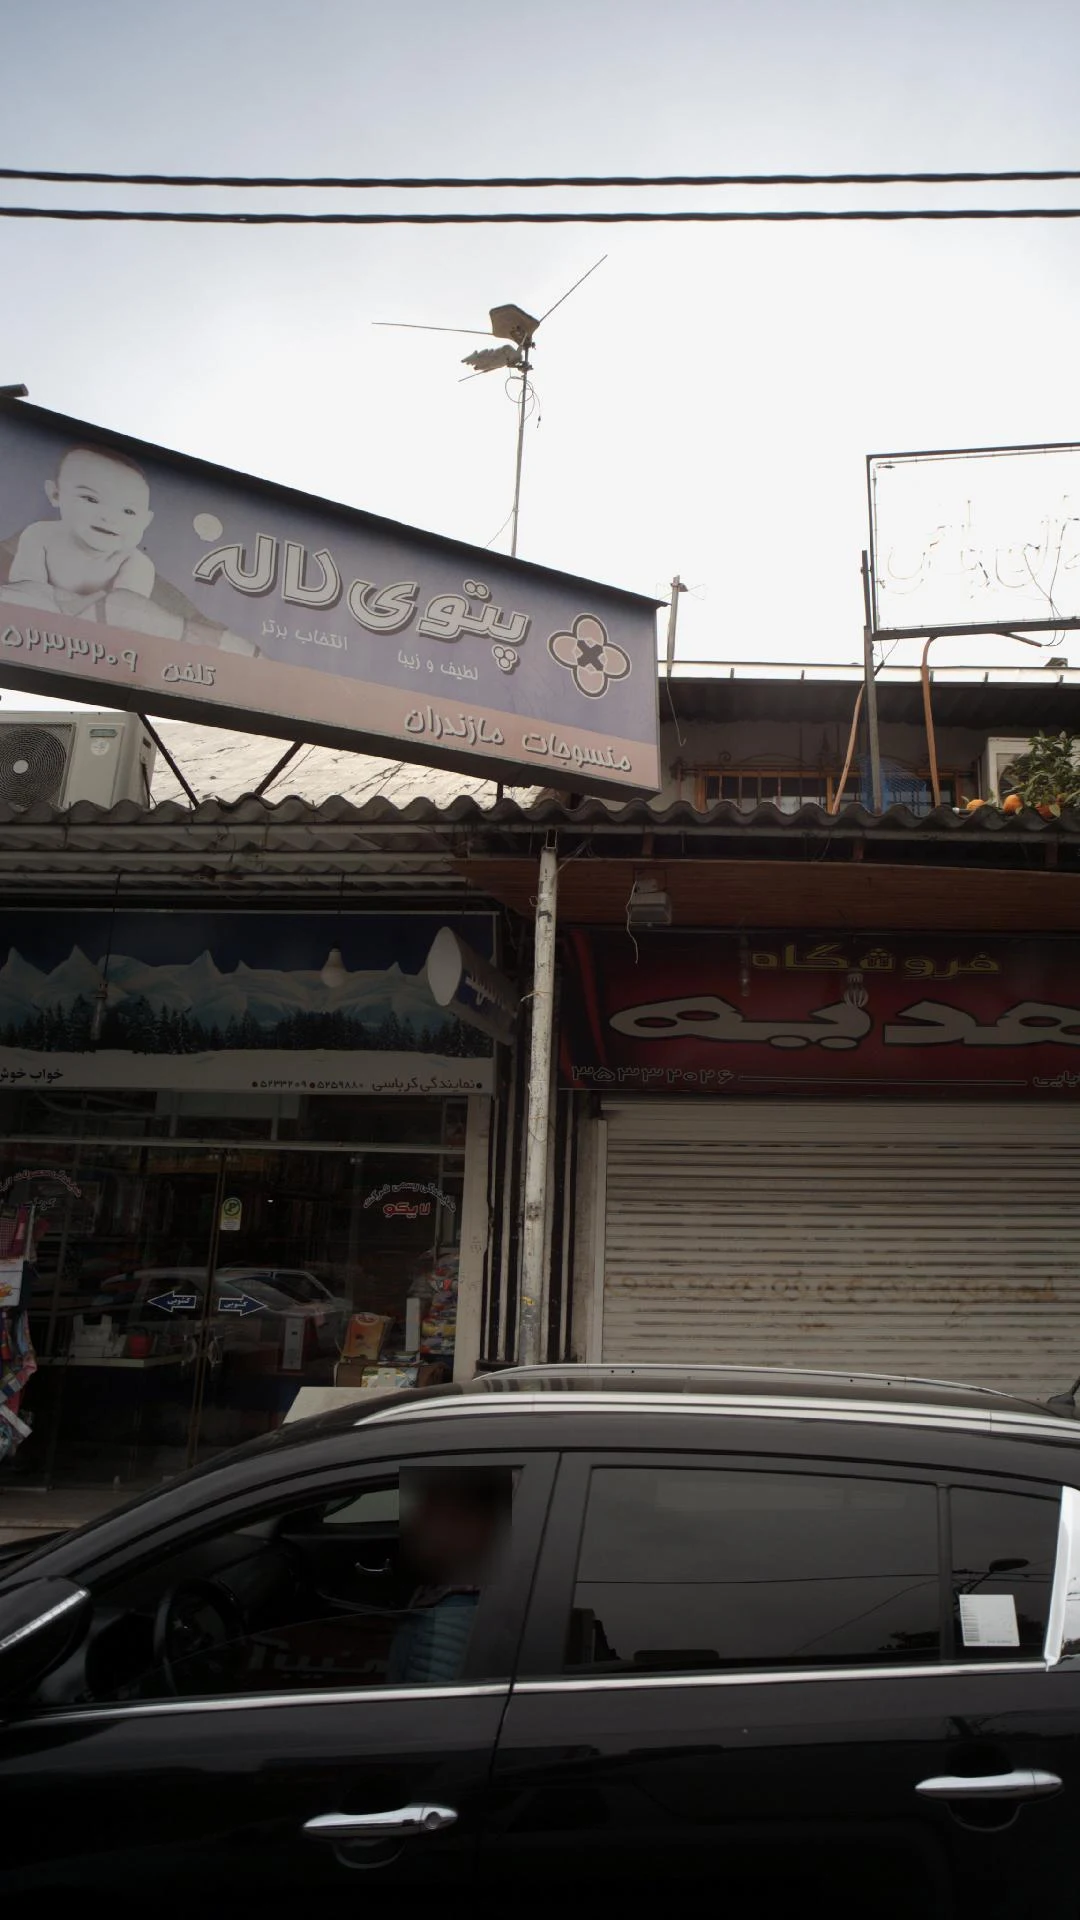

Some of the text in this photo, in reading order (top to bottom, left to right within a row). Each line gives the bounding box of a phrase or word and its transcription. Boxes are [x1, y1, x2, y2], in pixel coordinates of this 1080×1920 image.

[261, 618, 348, 650] انتخاب برتر
[347, 579, 530, 672] پتوی
[2, 624, 217, 686] تلفن ۵۲۳۳۲۰۹
[397, 650, 479, 681] لطیف و زیبا
[404, 706, 633, 773] منسوجات مازندران
[751, 942, 1000, 980] فروشگاه
[29, 1068, 63, 1083] خواب
[420, 1077, 476, 1092] نمایندگی
